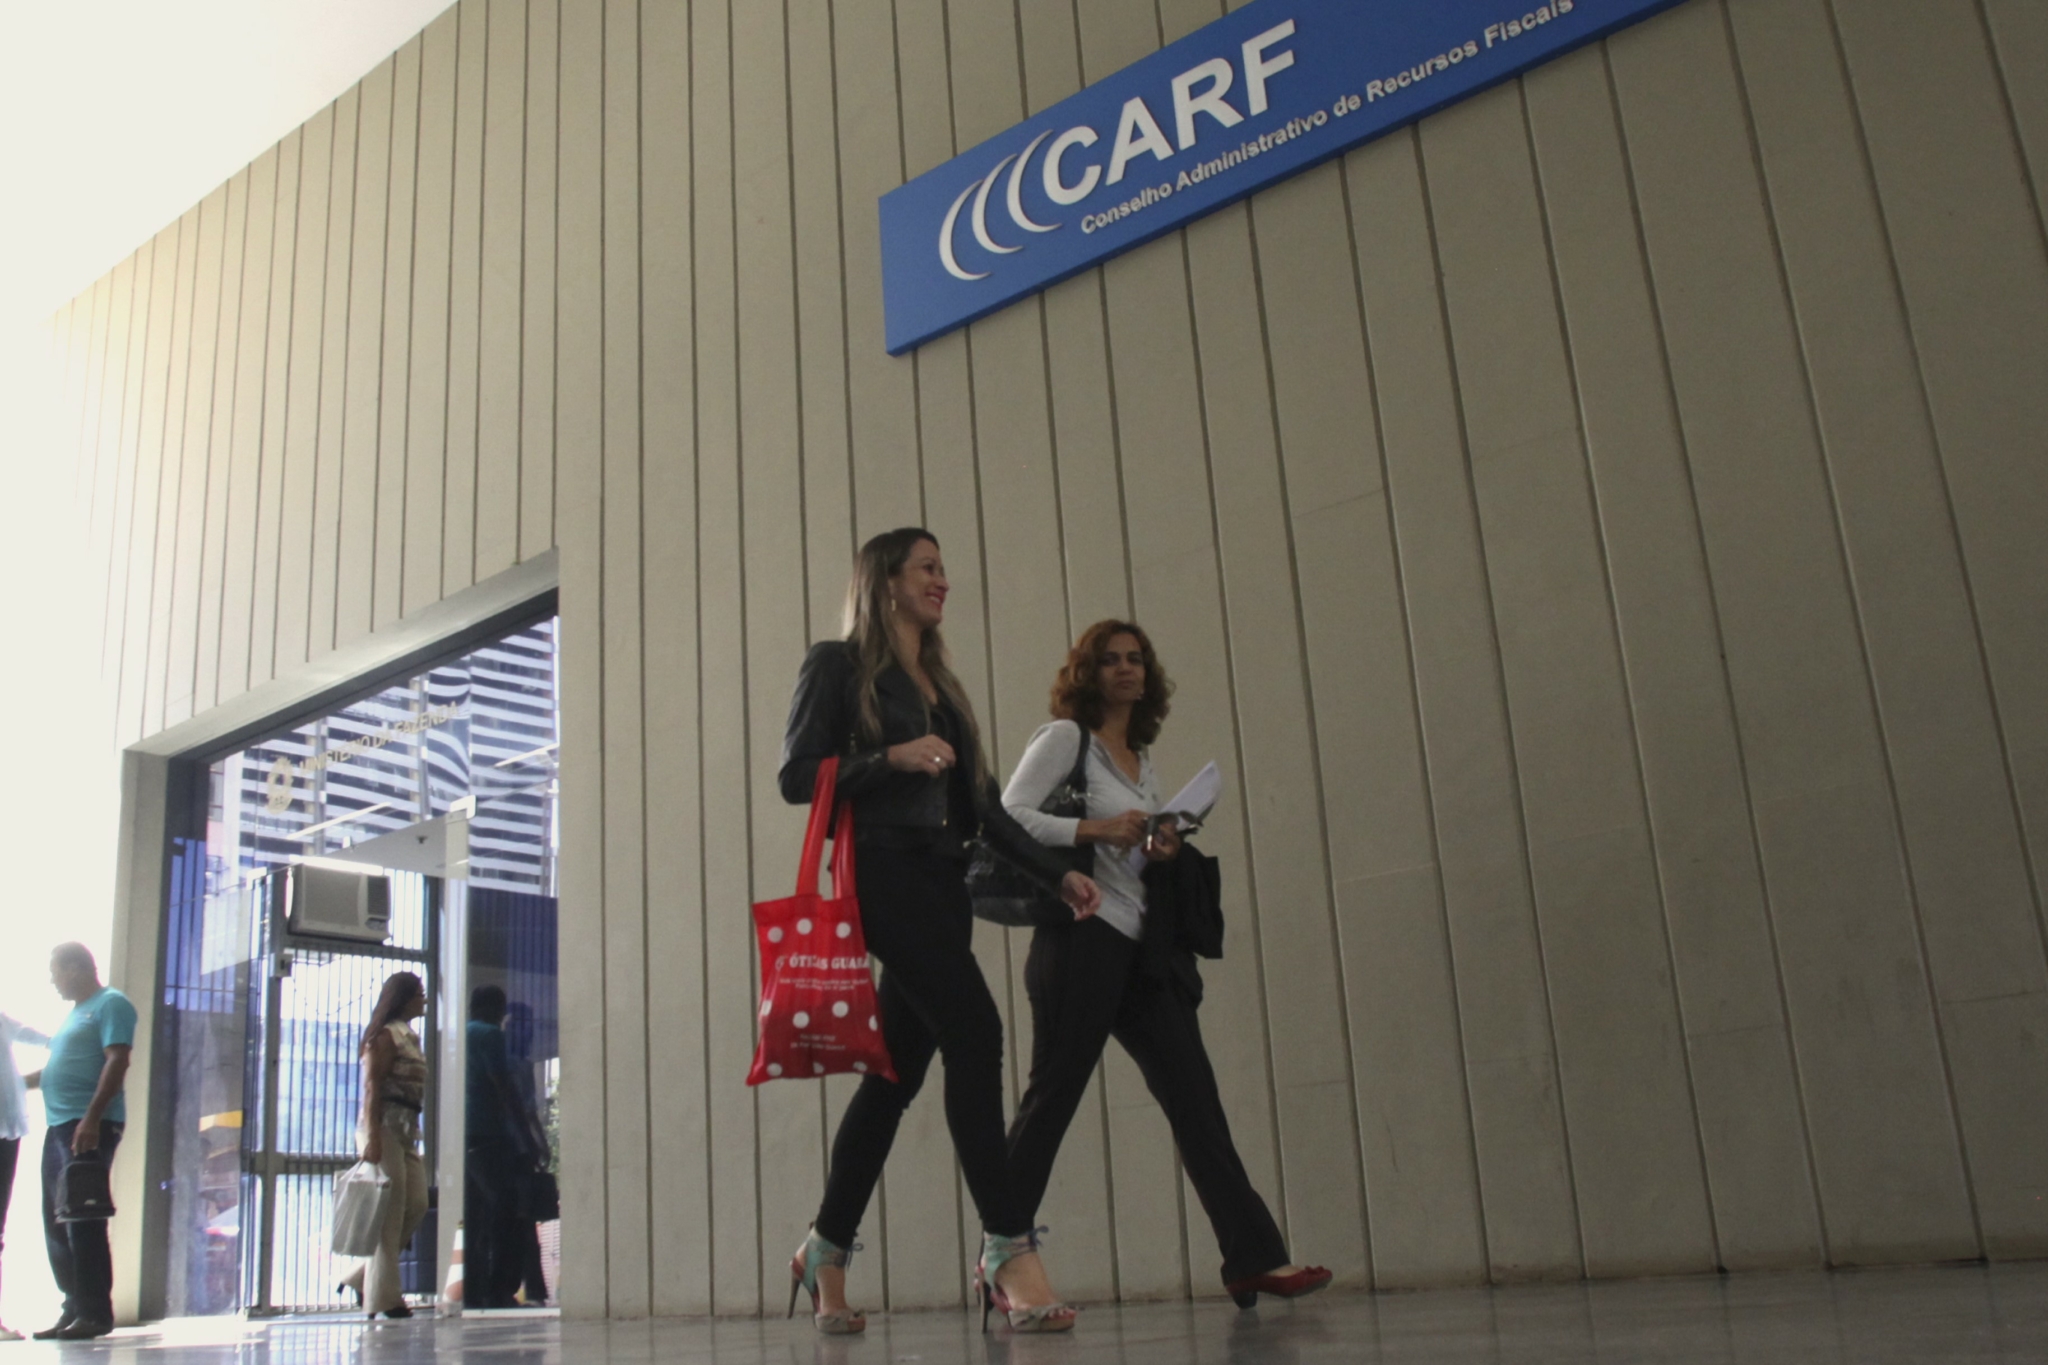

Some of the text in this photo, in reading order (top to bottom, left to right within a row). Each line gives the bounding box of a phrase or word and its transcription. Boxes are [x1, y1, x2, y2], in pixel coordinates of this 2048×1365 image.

[1043, 18, 1296, 206] CARF
[1080, 0, 1574, 235] Conselho Administrativo de Recursos Fiscais
